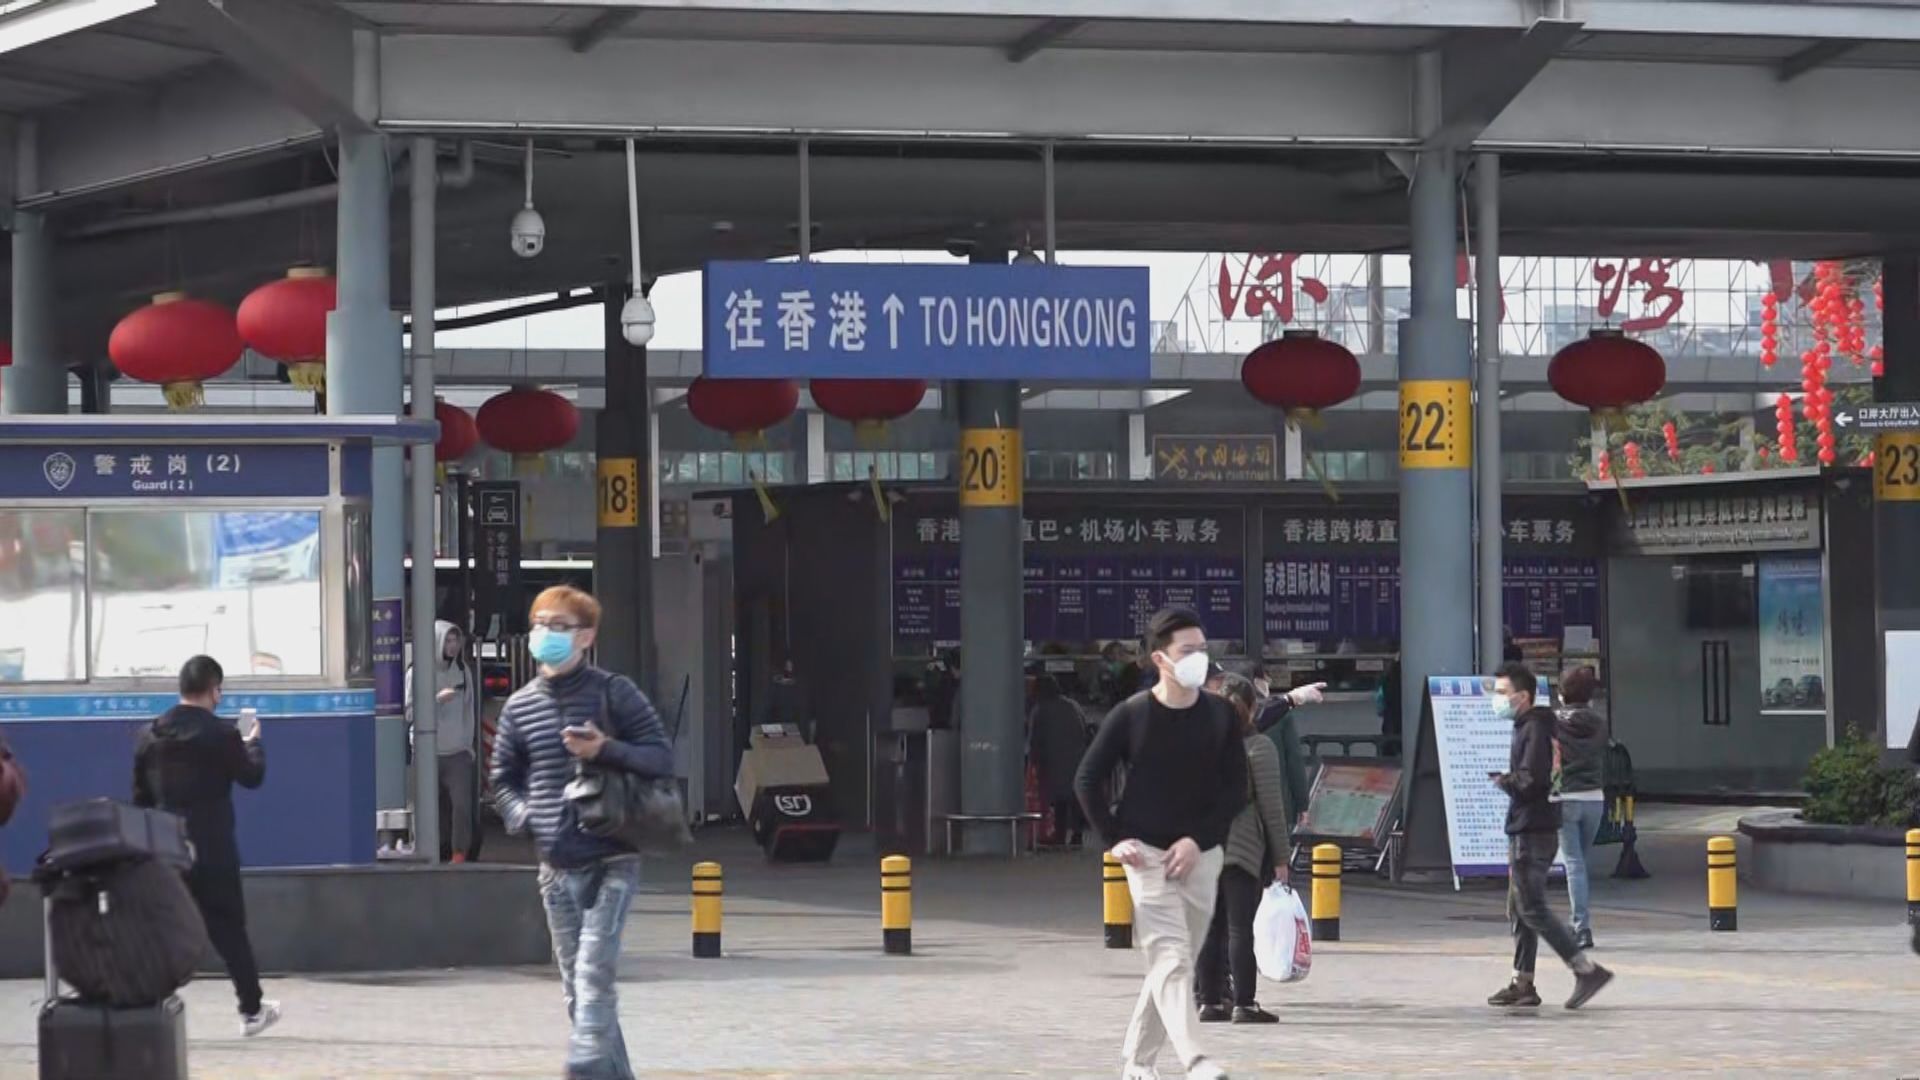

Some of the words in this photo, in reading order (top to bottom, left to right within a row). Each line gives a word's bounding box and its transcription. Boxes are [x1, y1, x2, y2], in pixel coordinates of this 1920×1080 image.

[724, 289, 867, 351] 往香港
[919, 297, 958, 348] TO
[966, 297, 1137, 349] HONGKONG
[1406, 401, 1446, 452] 22
[964, 447, 999, 491] 20
[1884, 443, 1919, 486] 23
[601, 475, 628, 513] 18
